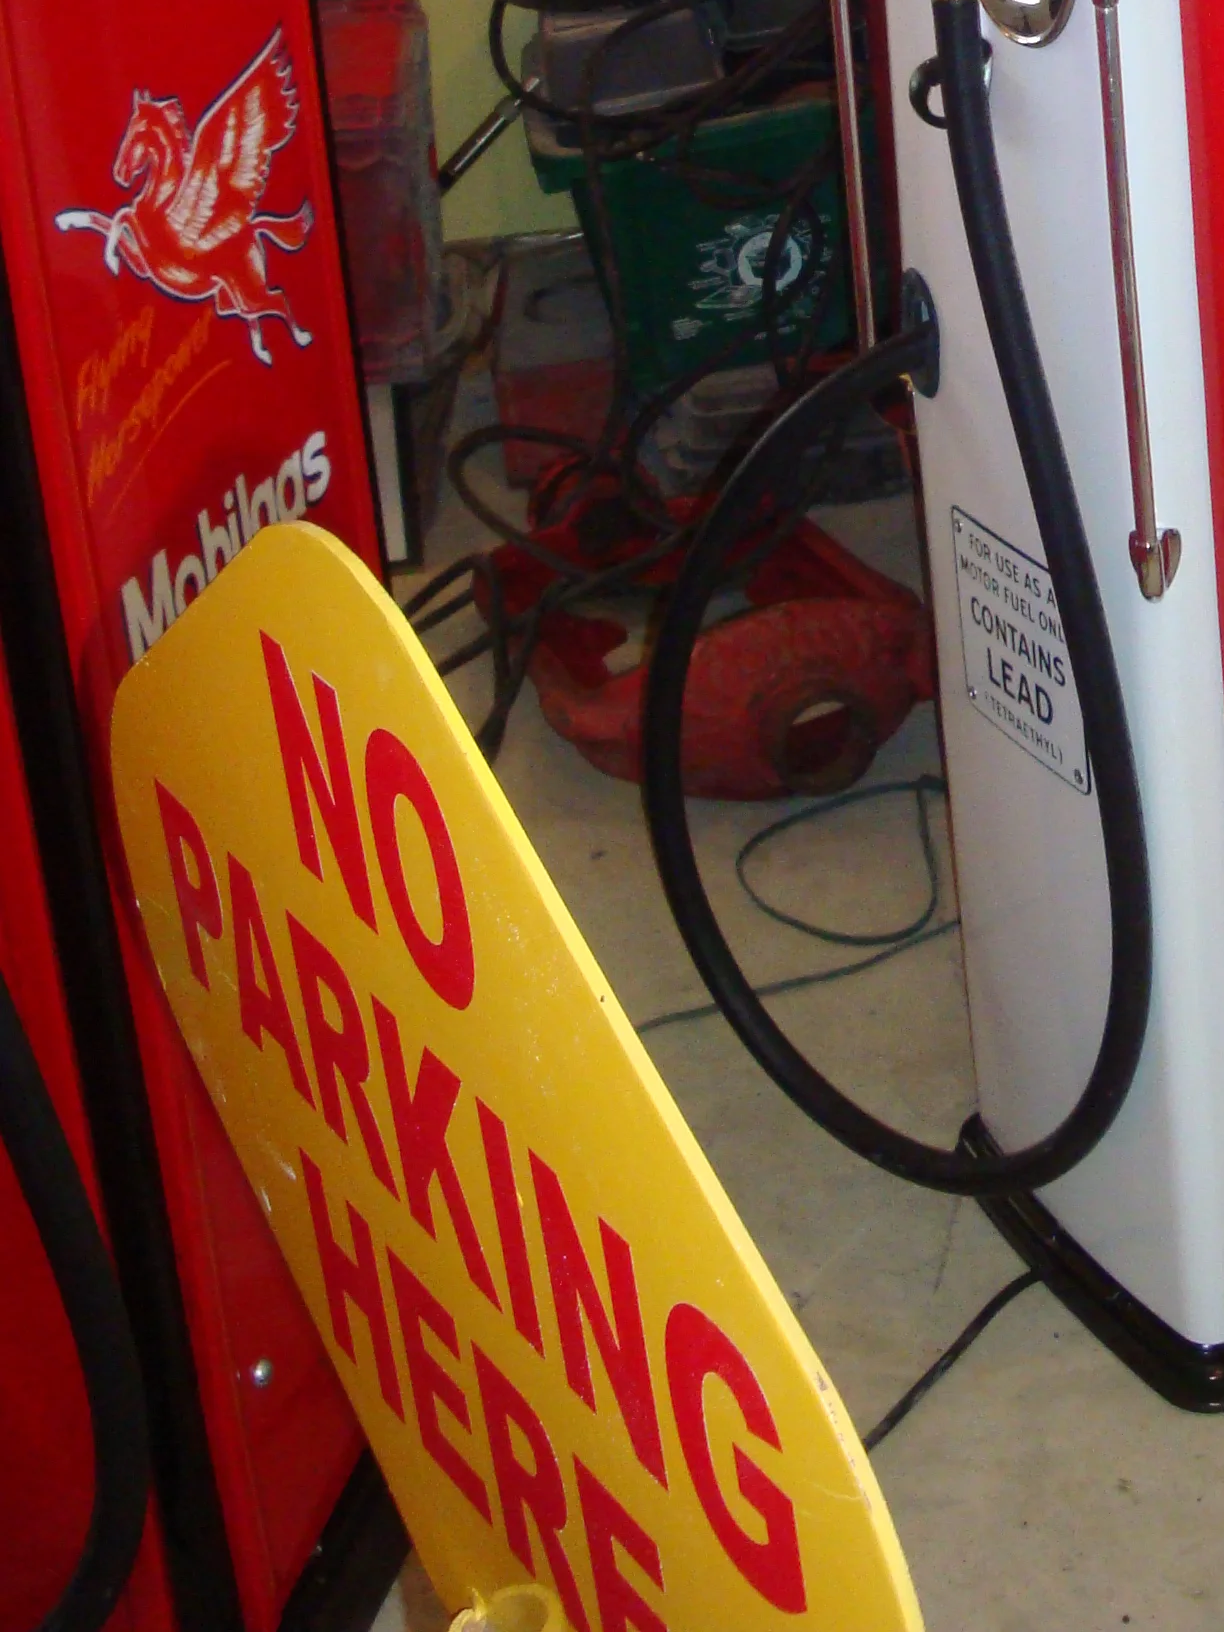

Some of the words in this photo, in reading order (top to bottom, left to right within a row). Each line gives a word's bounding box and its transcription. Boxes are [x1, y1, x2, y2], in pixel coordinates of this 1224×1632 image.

[960, 554, 1000, 597] MOTOR
[1004, 586, 1035, 624] FUEL
[1038, 610, 1065, 644] ONL
[968, 533, 991, 561] FOR
[995, 551, 1019, 584] USE
[1024, 572, 1042, 599] AS
[970, 596, 1067, 688] CONTAINS
[986, 646, 1054, 726] LEAD
[259, 628, 475, 1011] NO
[154, 777, 808, 1615] PARKING
[298, 1146, 668, 1632] HERE
